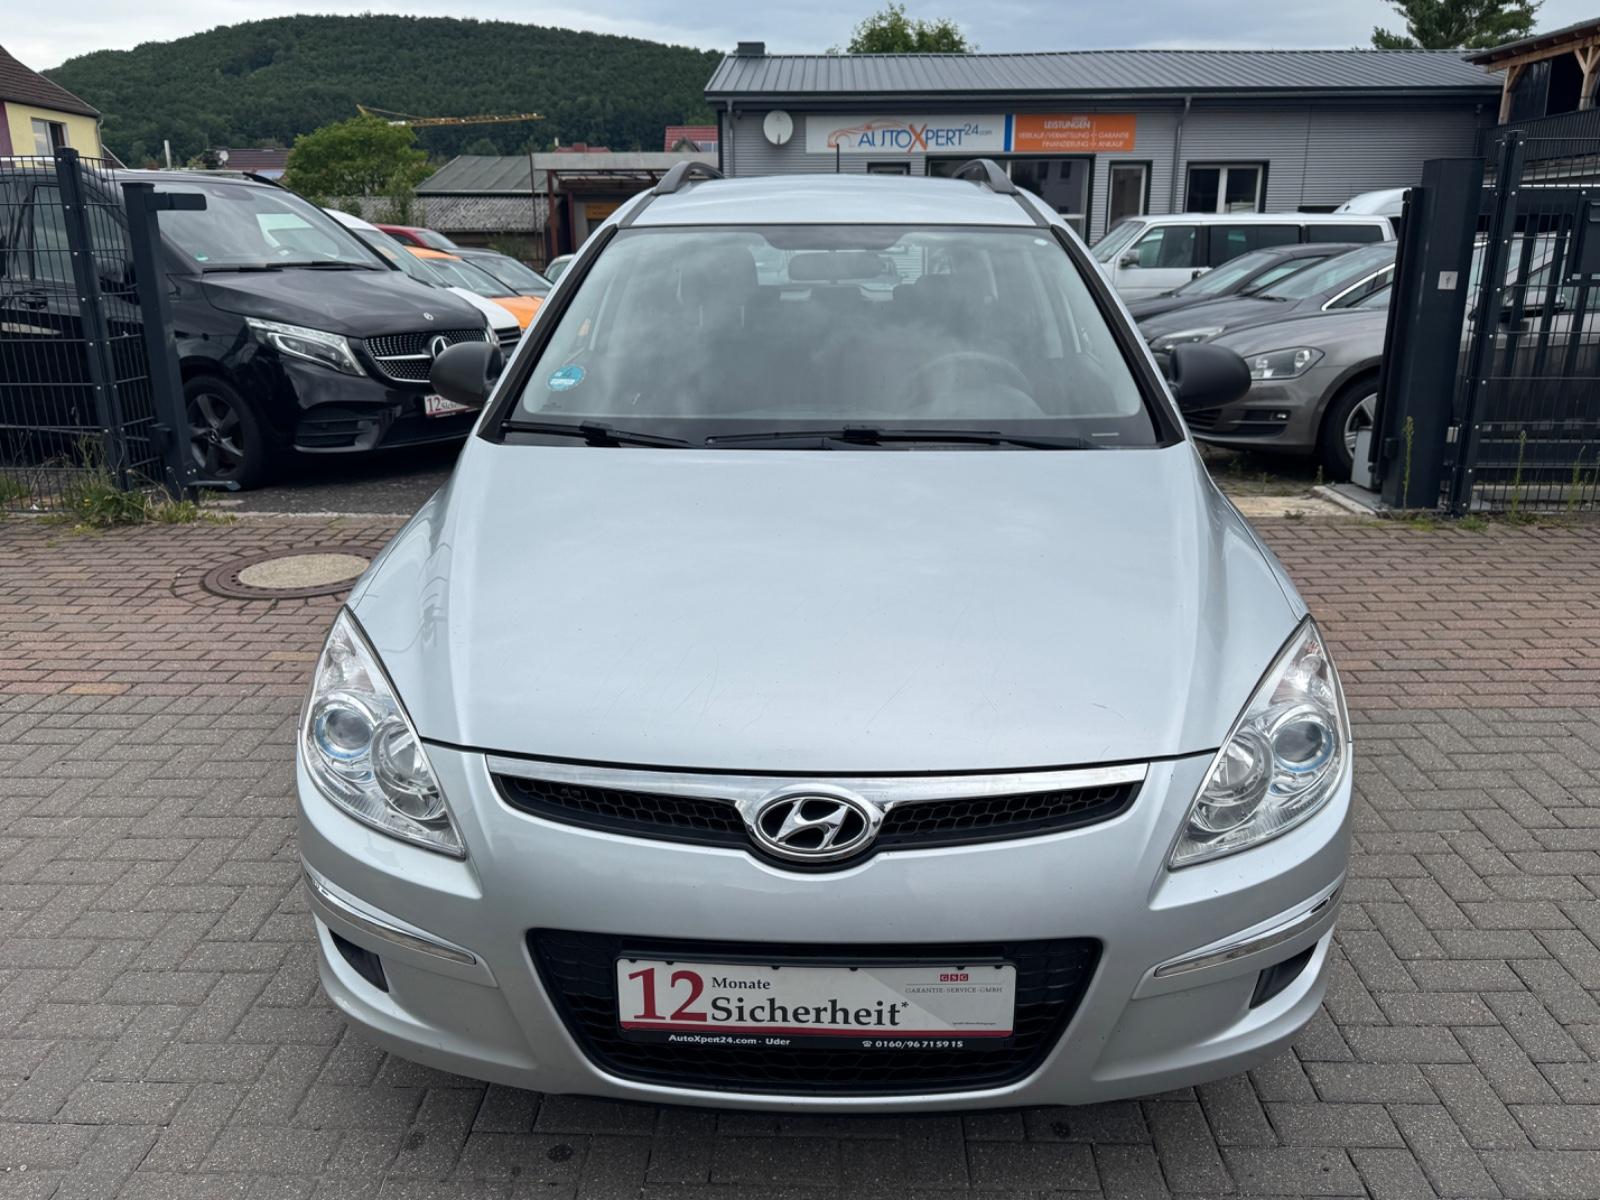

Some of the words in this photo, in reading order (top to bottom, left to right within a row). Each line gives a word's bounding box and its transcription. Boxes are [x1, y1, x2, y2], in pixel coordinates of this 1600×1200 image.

[1043, 120, 1091, 129] LEISTUNGEN
[427, 396, 441, 412] 12
[628, 967, 708, 1022] 12
[711, 976, 771, 990] Monate
[668, 1034, 757, 1045] AutoXpert24.com
